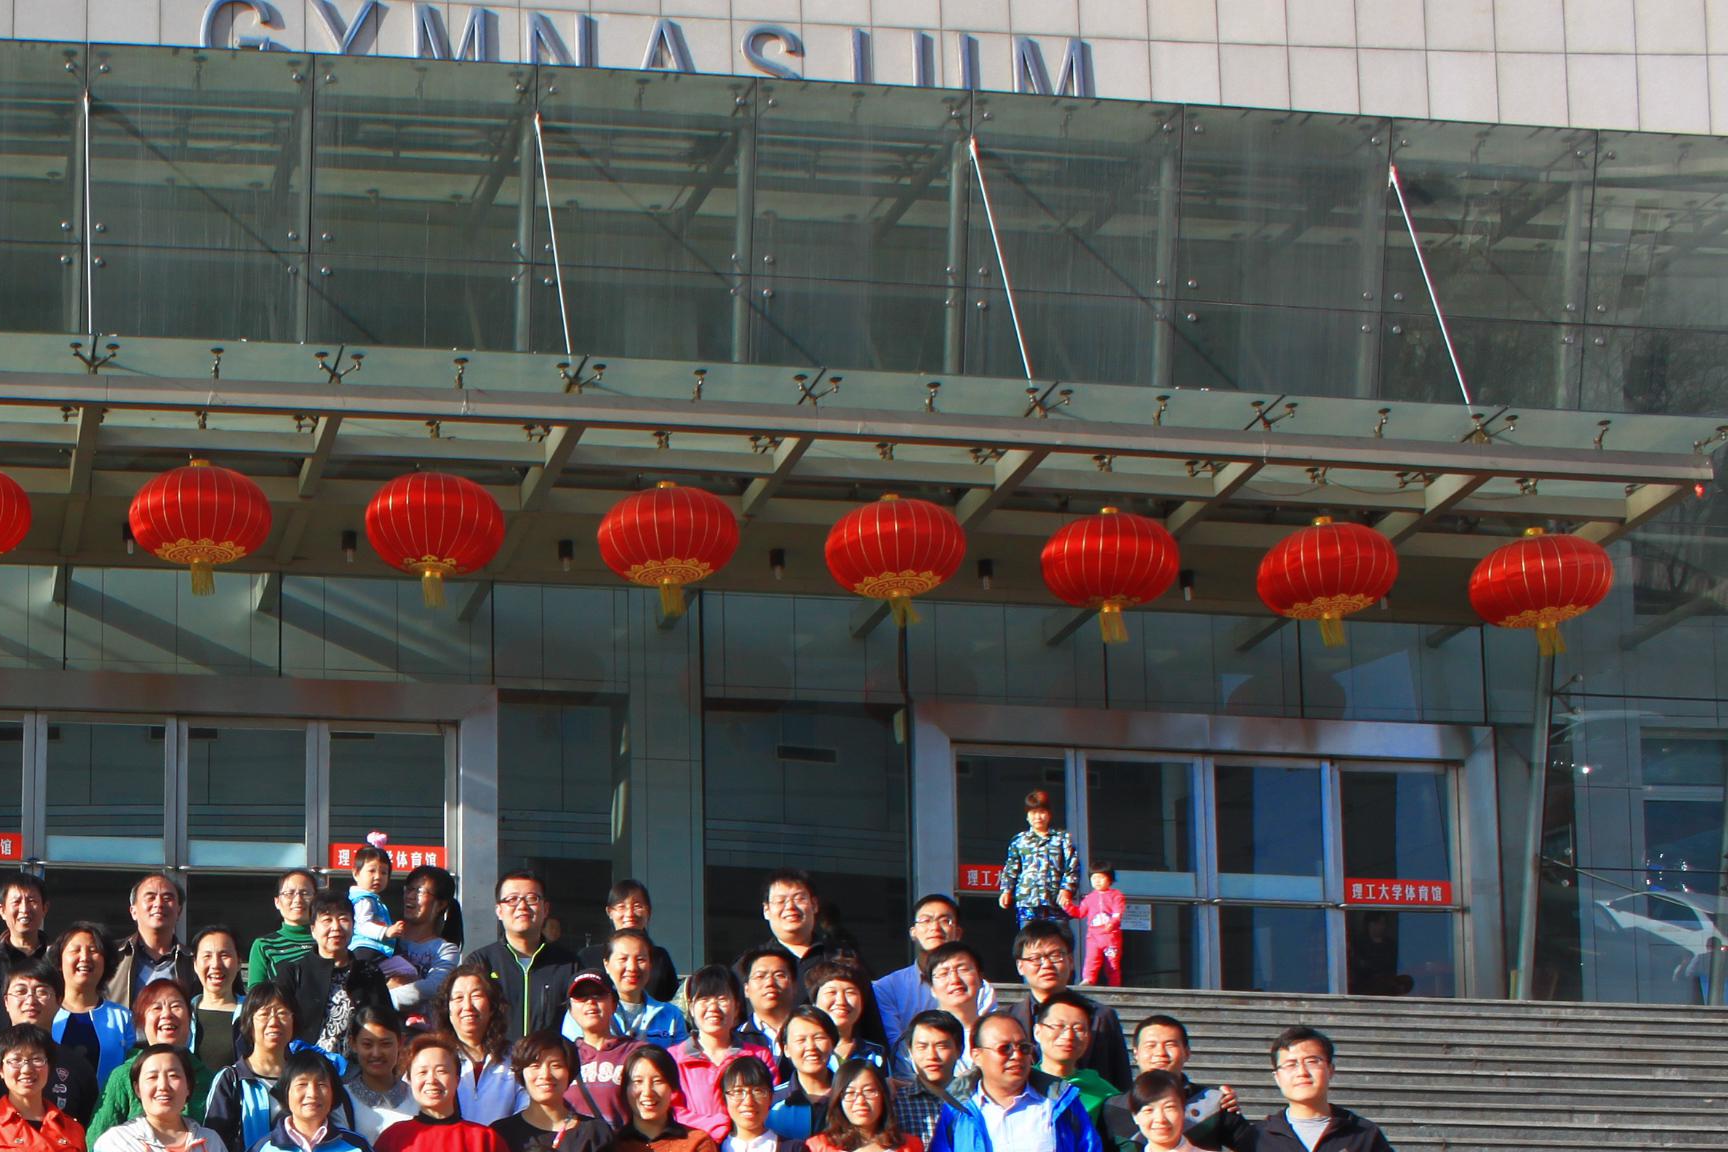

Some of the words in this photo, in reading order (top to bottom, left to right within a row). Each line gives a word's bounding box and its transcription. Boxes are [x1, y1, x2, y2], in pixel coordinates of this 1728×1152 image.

[199, 0, 1085, 97] GYMNASIUM
[338, 848, 438, 869] 理体育馆
[1352, 882, 1442, 902] 理工大学体育馆
